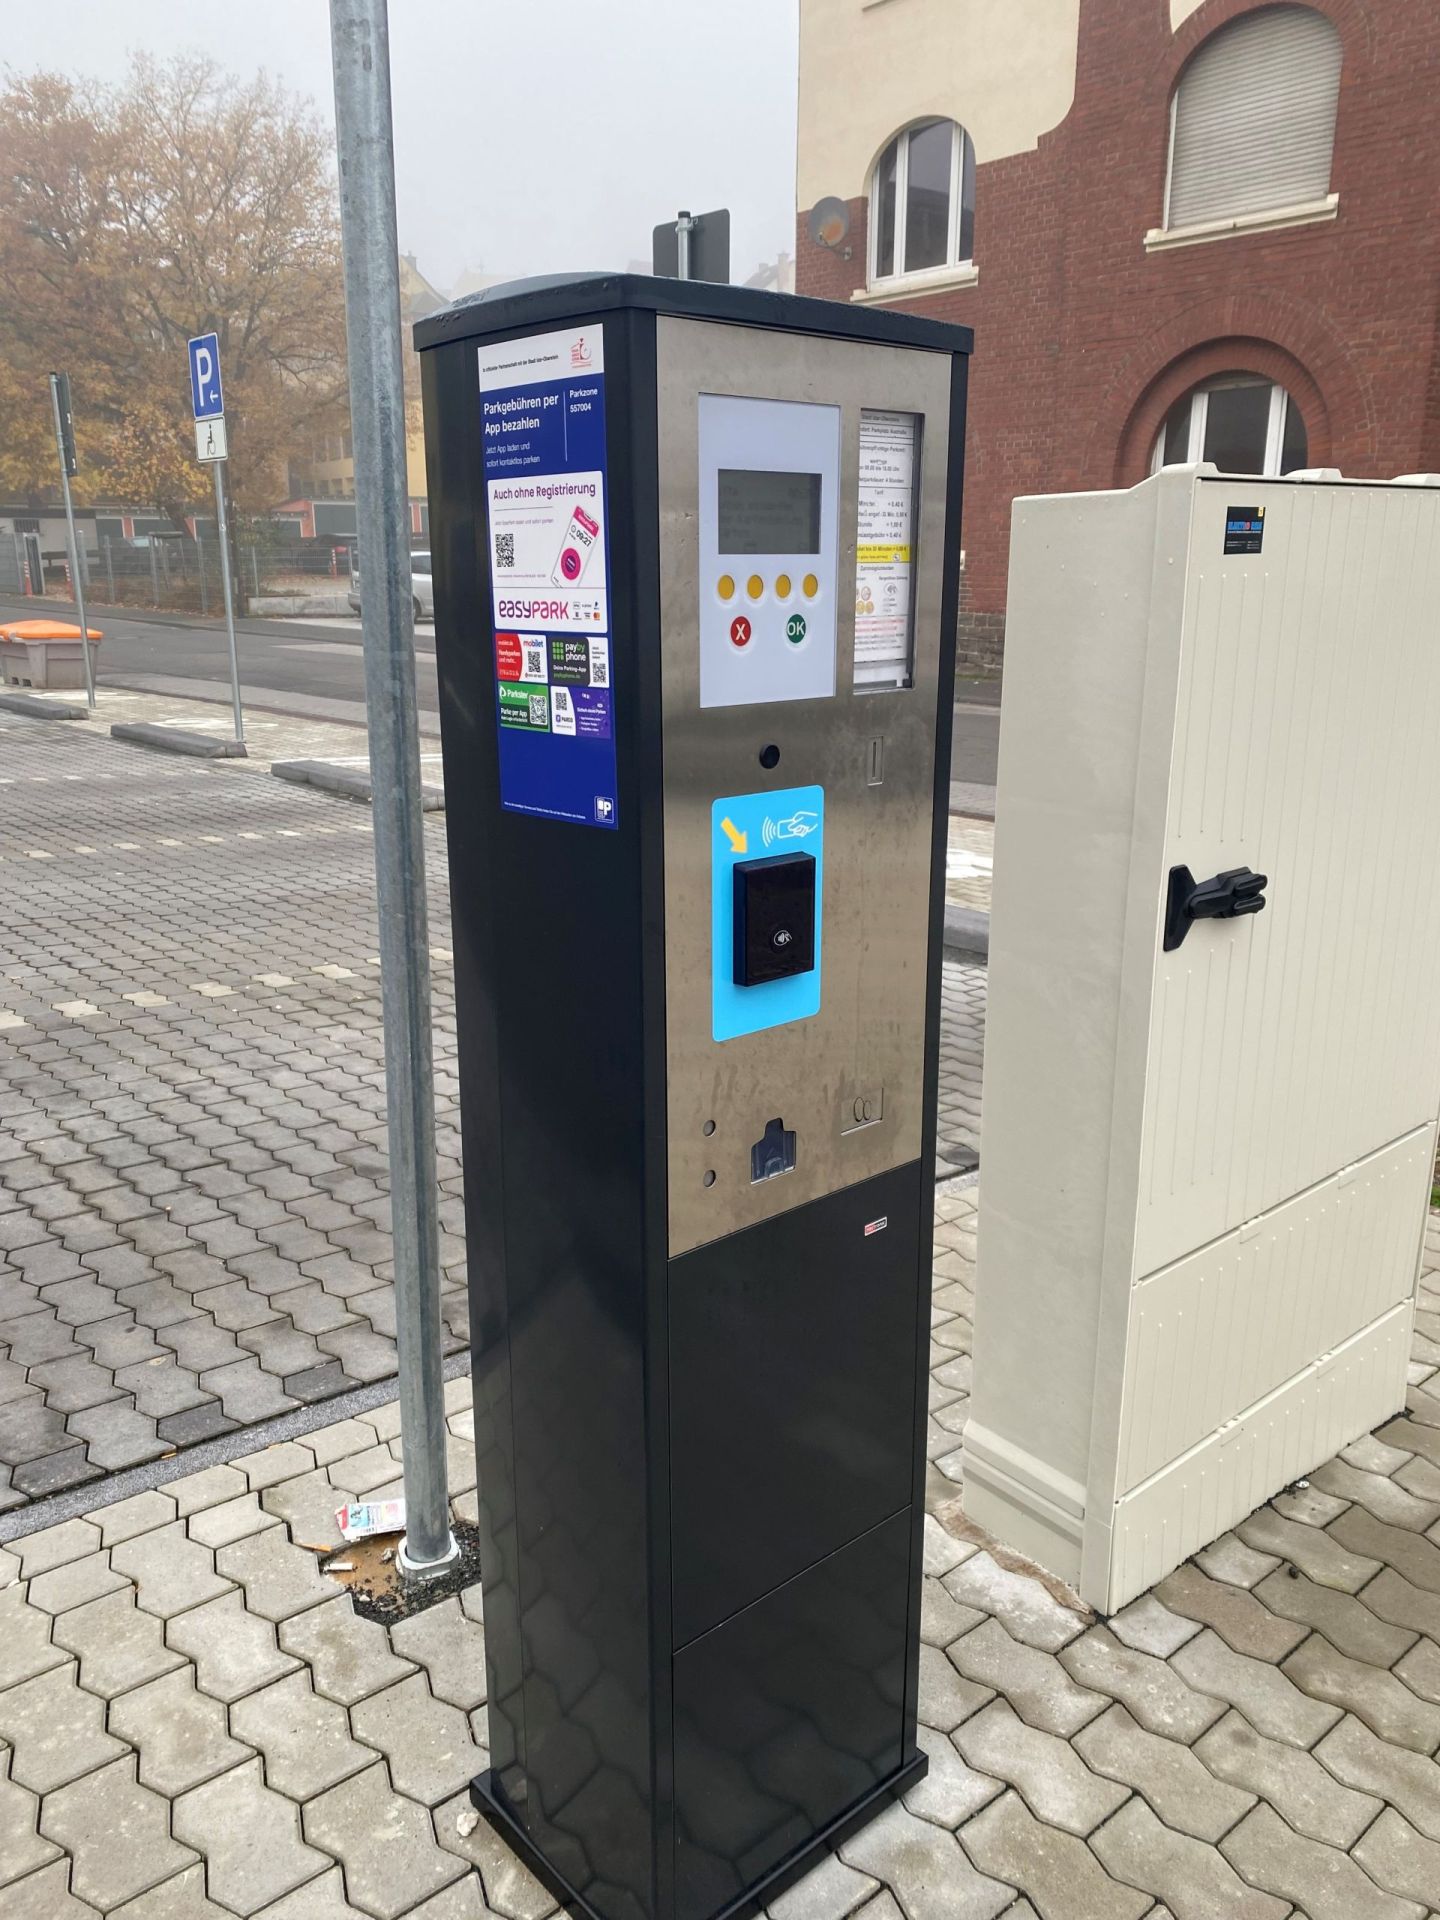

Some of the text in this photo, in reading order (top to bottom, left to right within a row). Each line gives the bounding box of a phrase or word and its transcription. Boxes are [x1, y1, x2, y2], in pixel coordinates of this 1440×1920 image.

[196, 347, 212, 408] P
[570, 387, 598, 399] Parkzone
[484, 394, 559, 415] Parkgebühren per
[570, 403, 592, 413] 557004
[485, 417, 540, 436] App bezahlen
[486, 445, 496, 454] Jetzt
[497, 444, 506, 453] App
[520, 442, 530, 450] und
[486, 456, 540, 467] sofort kontaktlos parken
[493, 483, 596, 500] Auch ohne Registrierung
[736, 624, 746, 640] X
[787, 622, 805, 636] OK
[523, 639, 544, 647] mobilet
[566, 652, 586, 662] phone
[507, 690, 528, 699] Parkster
